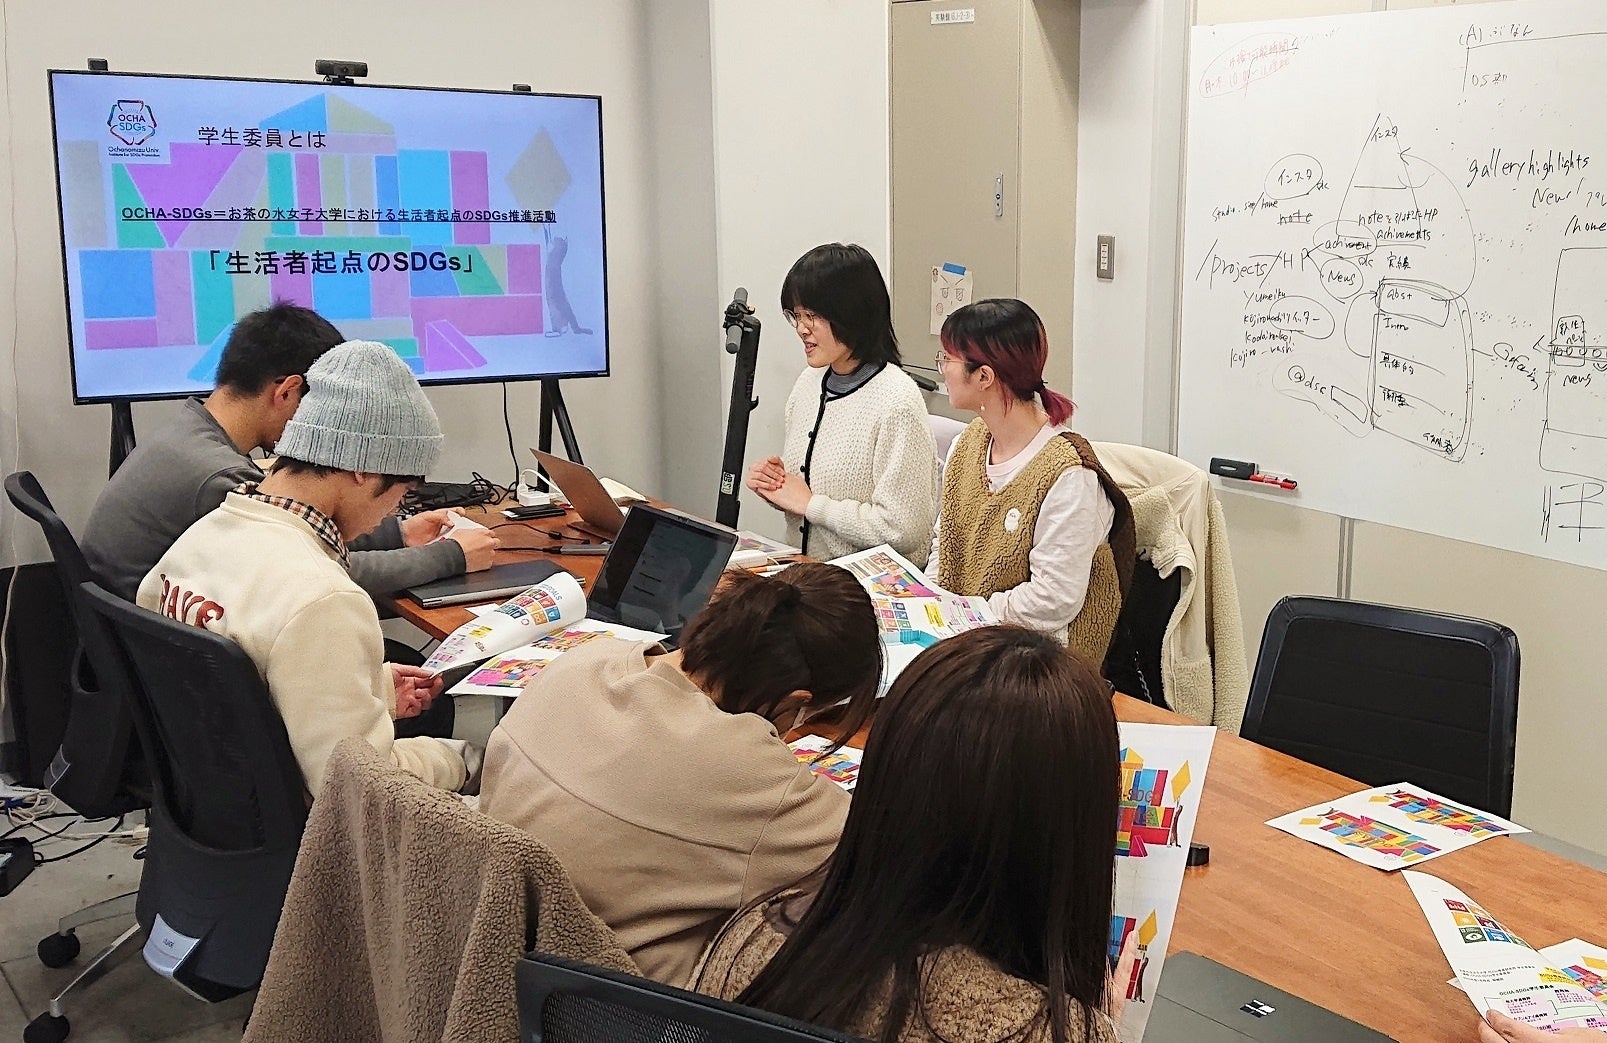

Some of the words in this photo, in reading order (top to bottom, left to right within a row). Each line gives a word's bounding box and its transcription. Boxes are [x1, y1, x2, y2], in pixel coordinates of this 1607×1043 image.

[118, 114, 146, 123] OCHA
[119, 122, 147, 132] SDGs
[197, 126, 328, 149] 学生委員とは
[208, 248, 475, 276] 「生活者起点のSDGs」
